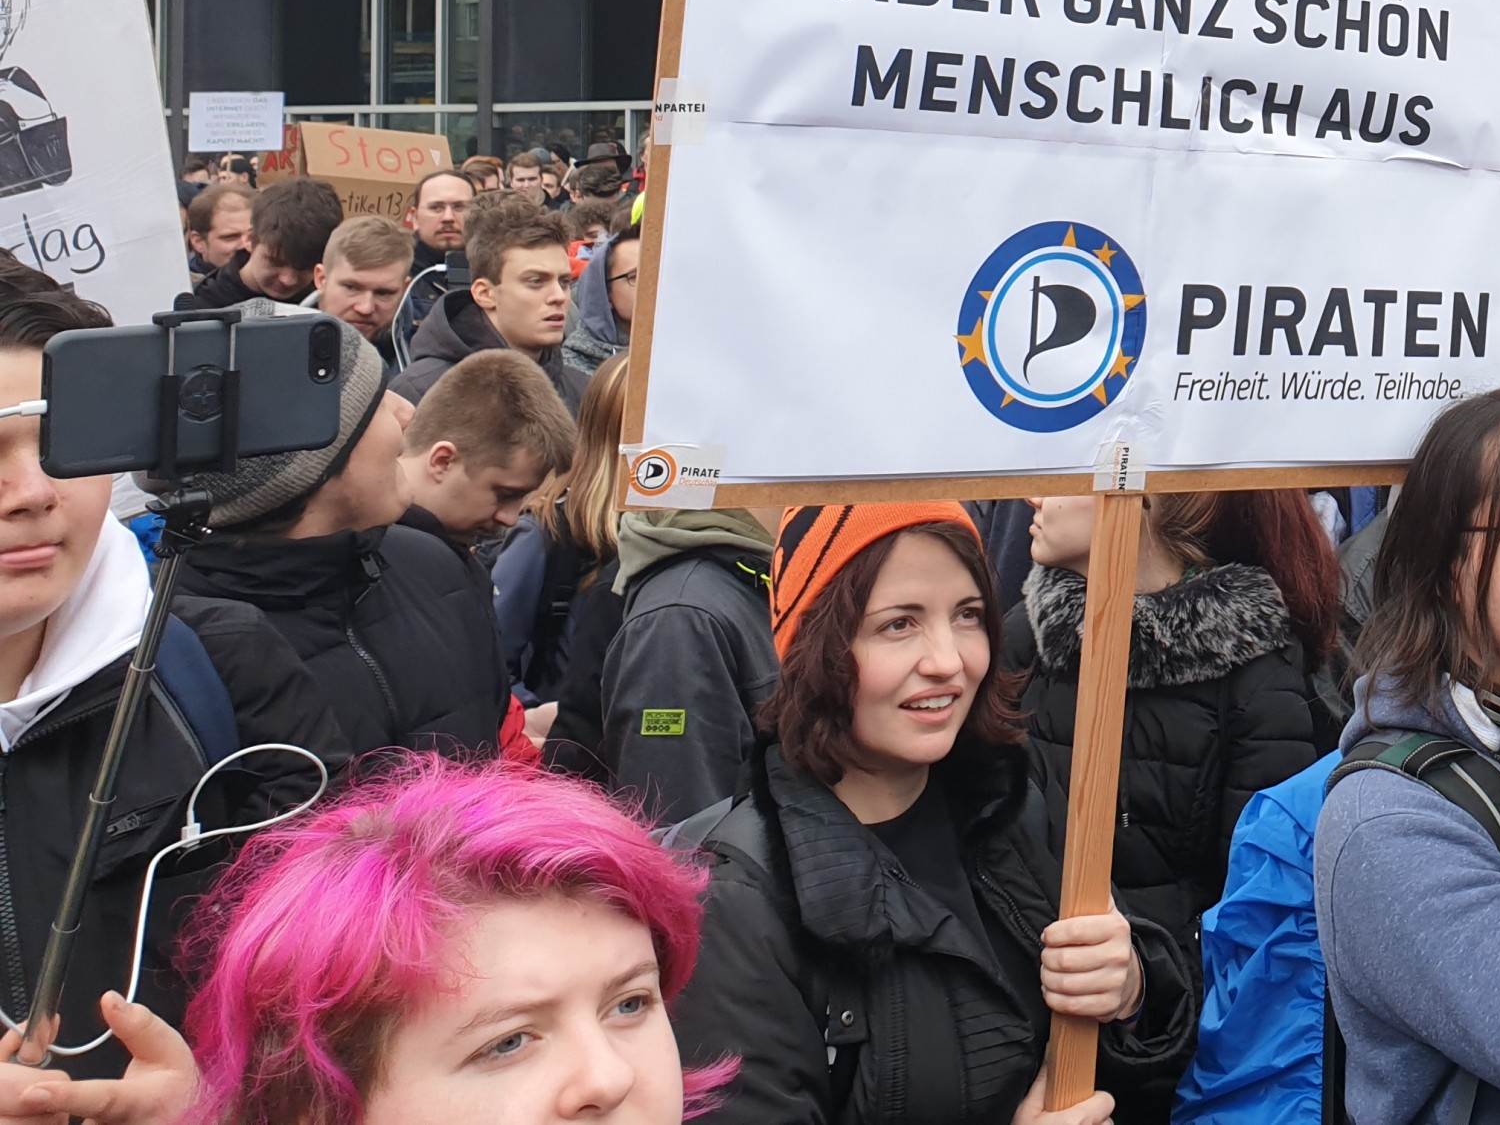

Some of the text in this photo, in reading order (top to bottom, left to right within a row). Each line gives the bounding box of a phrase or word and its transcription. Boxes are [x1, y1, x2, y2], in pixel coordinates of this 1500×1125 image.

[655, 103, 705, 113] NPARTEI
[851, 45, 1435, 146] MENSCHLICH AUS
[328, 129, 424, 176] Stop
[386, 191, 403, 216] 13
[1175, 283, 1491, 359] PIRATEN
[1173, 370, 1464, 402] Freiheit. Würde. Teilhabe.
[680, 466, 721, 478] PIRATE
